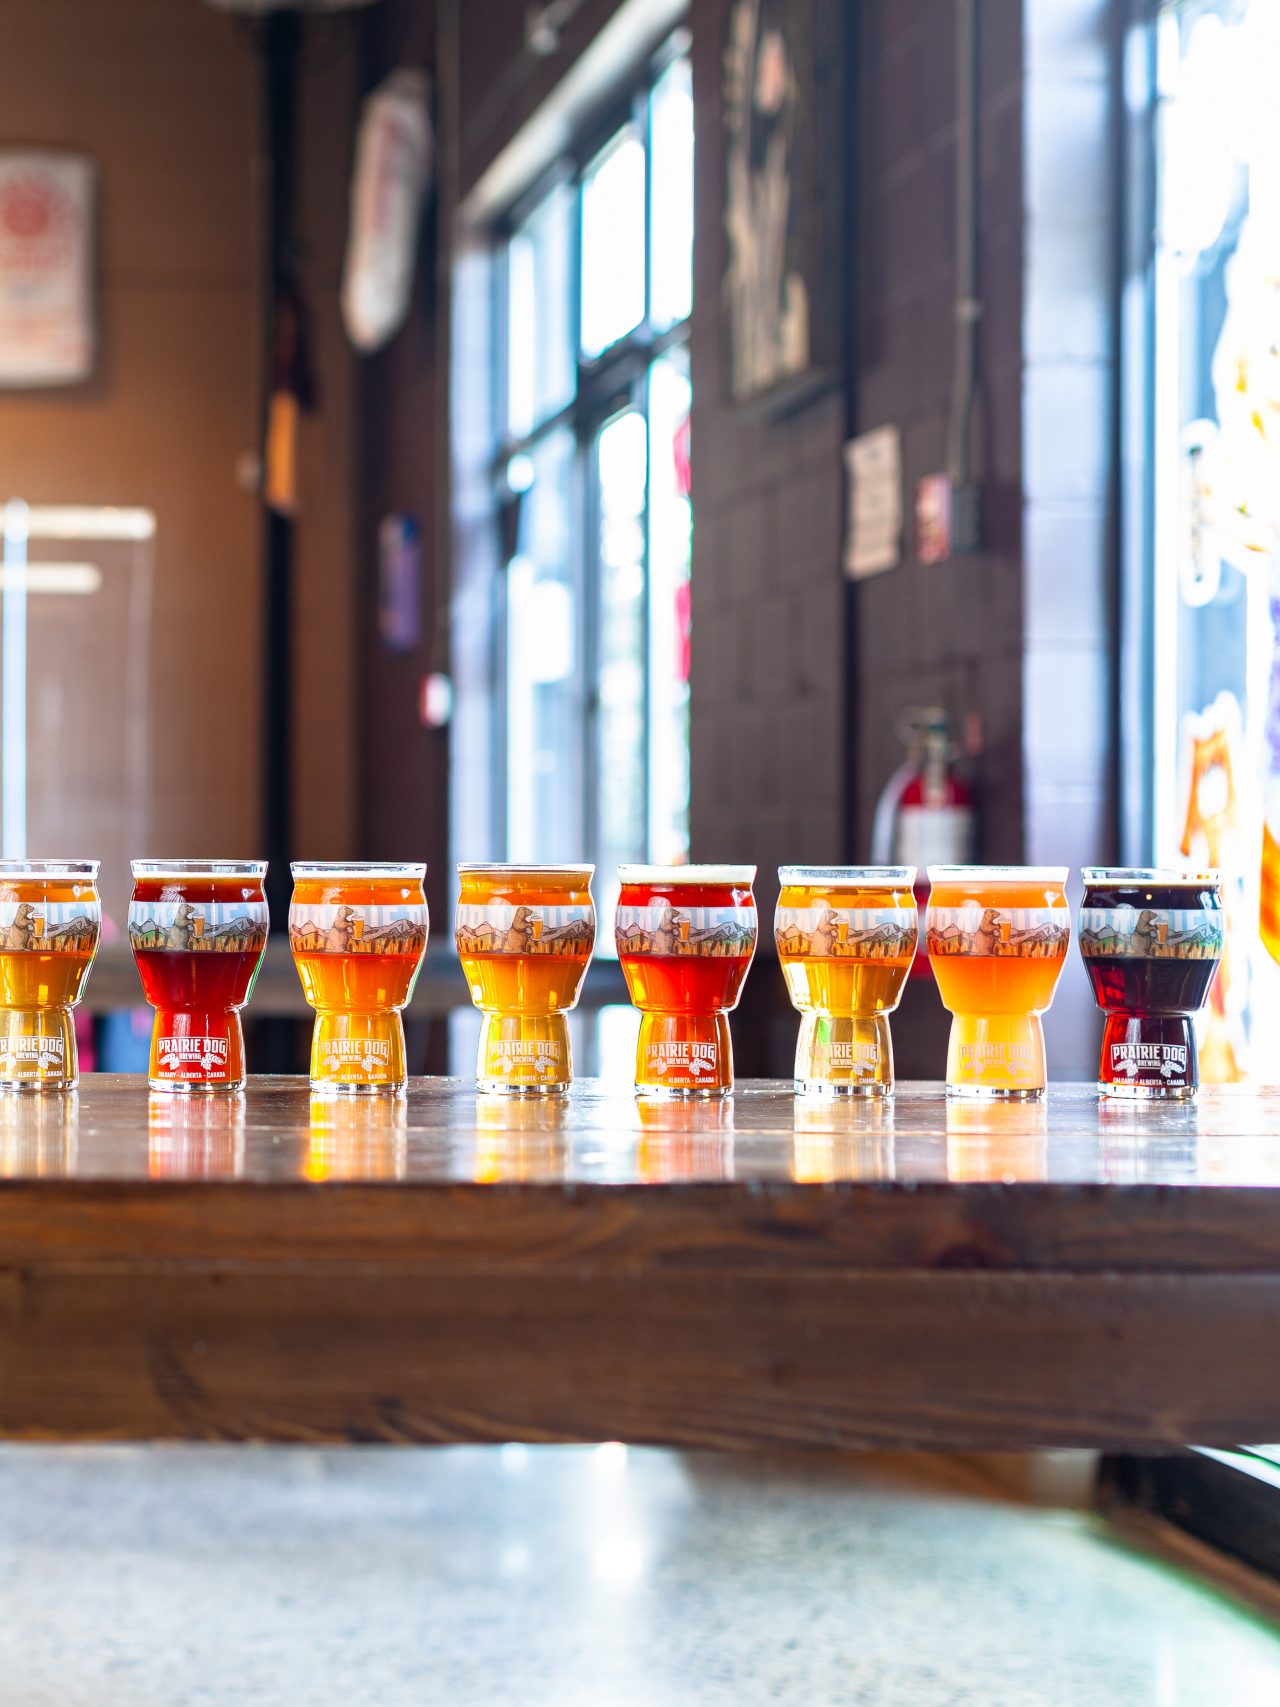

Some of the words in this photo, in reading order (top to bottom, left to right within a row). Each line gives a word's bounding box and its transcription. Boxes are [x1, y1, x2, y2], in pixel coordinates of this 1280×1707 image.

[40, 1039, 63, 1055] DOG
[159, 1039, 200, 1053] PRAIRIE
[204, 1039, 226, 1056] DOG
[320, 1040, 361, 1055] PRAIRIE
[364, 1041, 388, 1058] DOG
[538, 1042, 559, 1058] DOG
[646, 1044, 688, 1058] PRAIRIE
[692, 1044, 715, 1062] DOG
[856, 1045, 877, 1062] DOG
[1113, 1045, 1160, 1060] PRAIRIE
[1162, 1046, 1185, 1065] DOG
